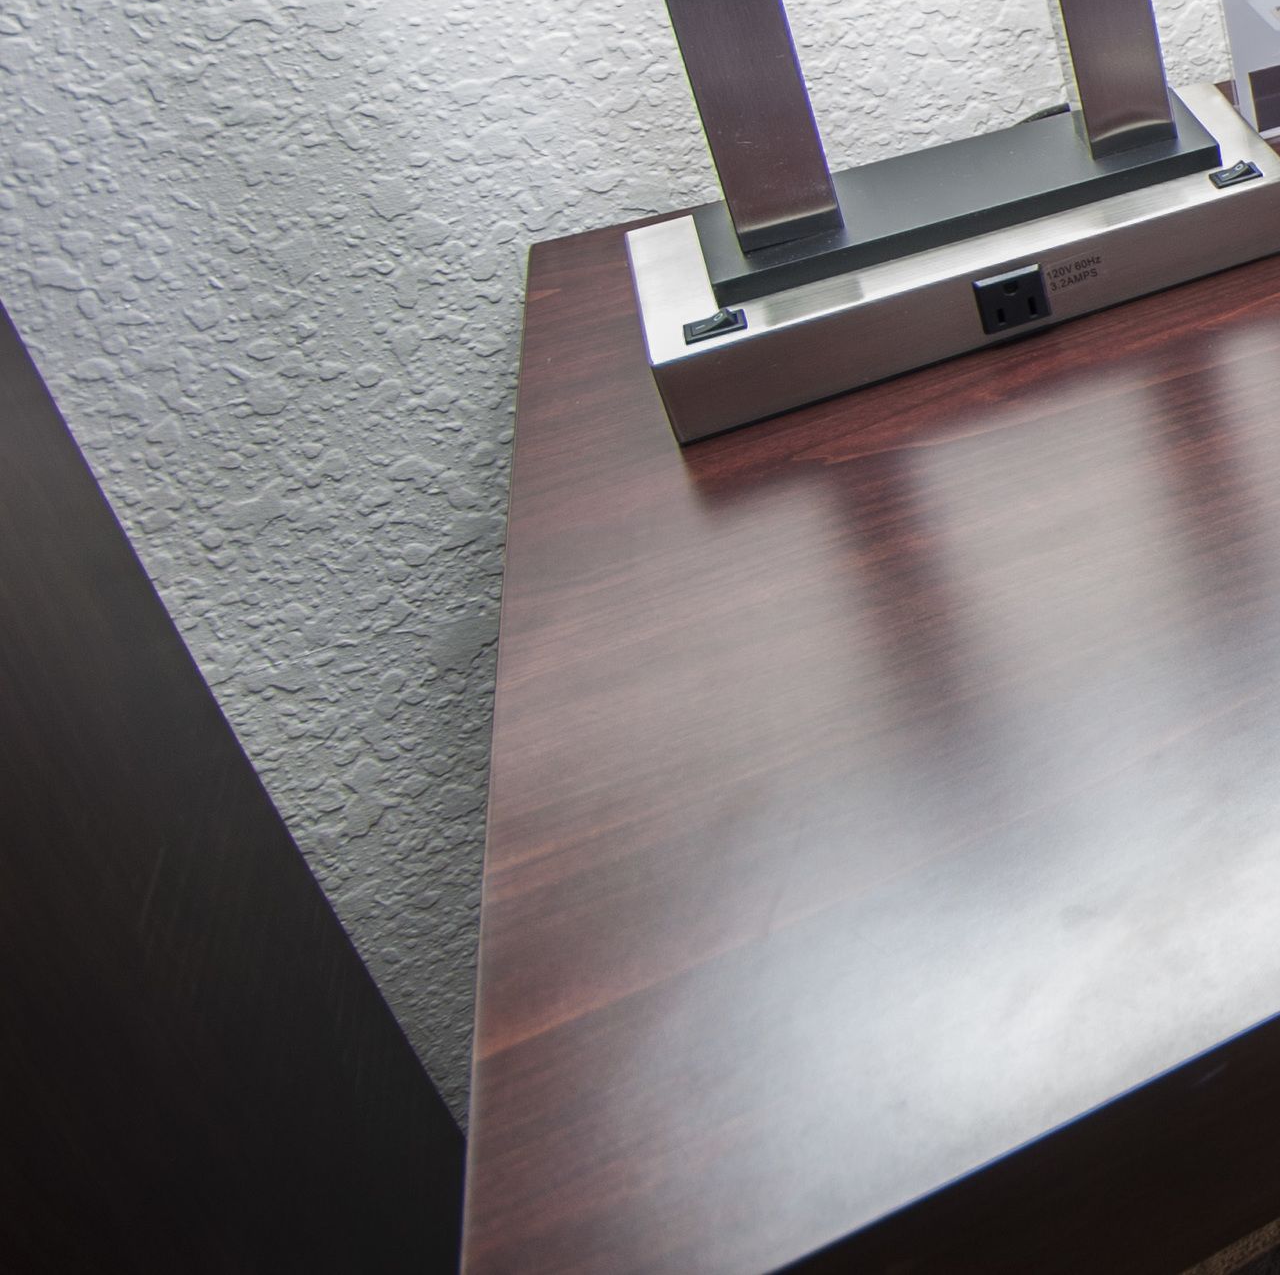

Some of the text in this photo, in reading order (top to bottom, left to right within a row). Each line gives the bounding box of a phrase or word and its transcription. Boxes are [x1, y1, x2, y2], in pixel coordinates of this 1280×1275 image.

[1047, 257, 1102, 279] 120V 60Hz
[1050, 268, 1098, 291] 3.2AMPS
